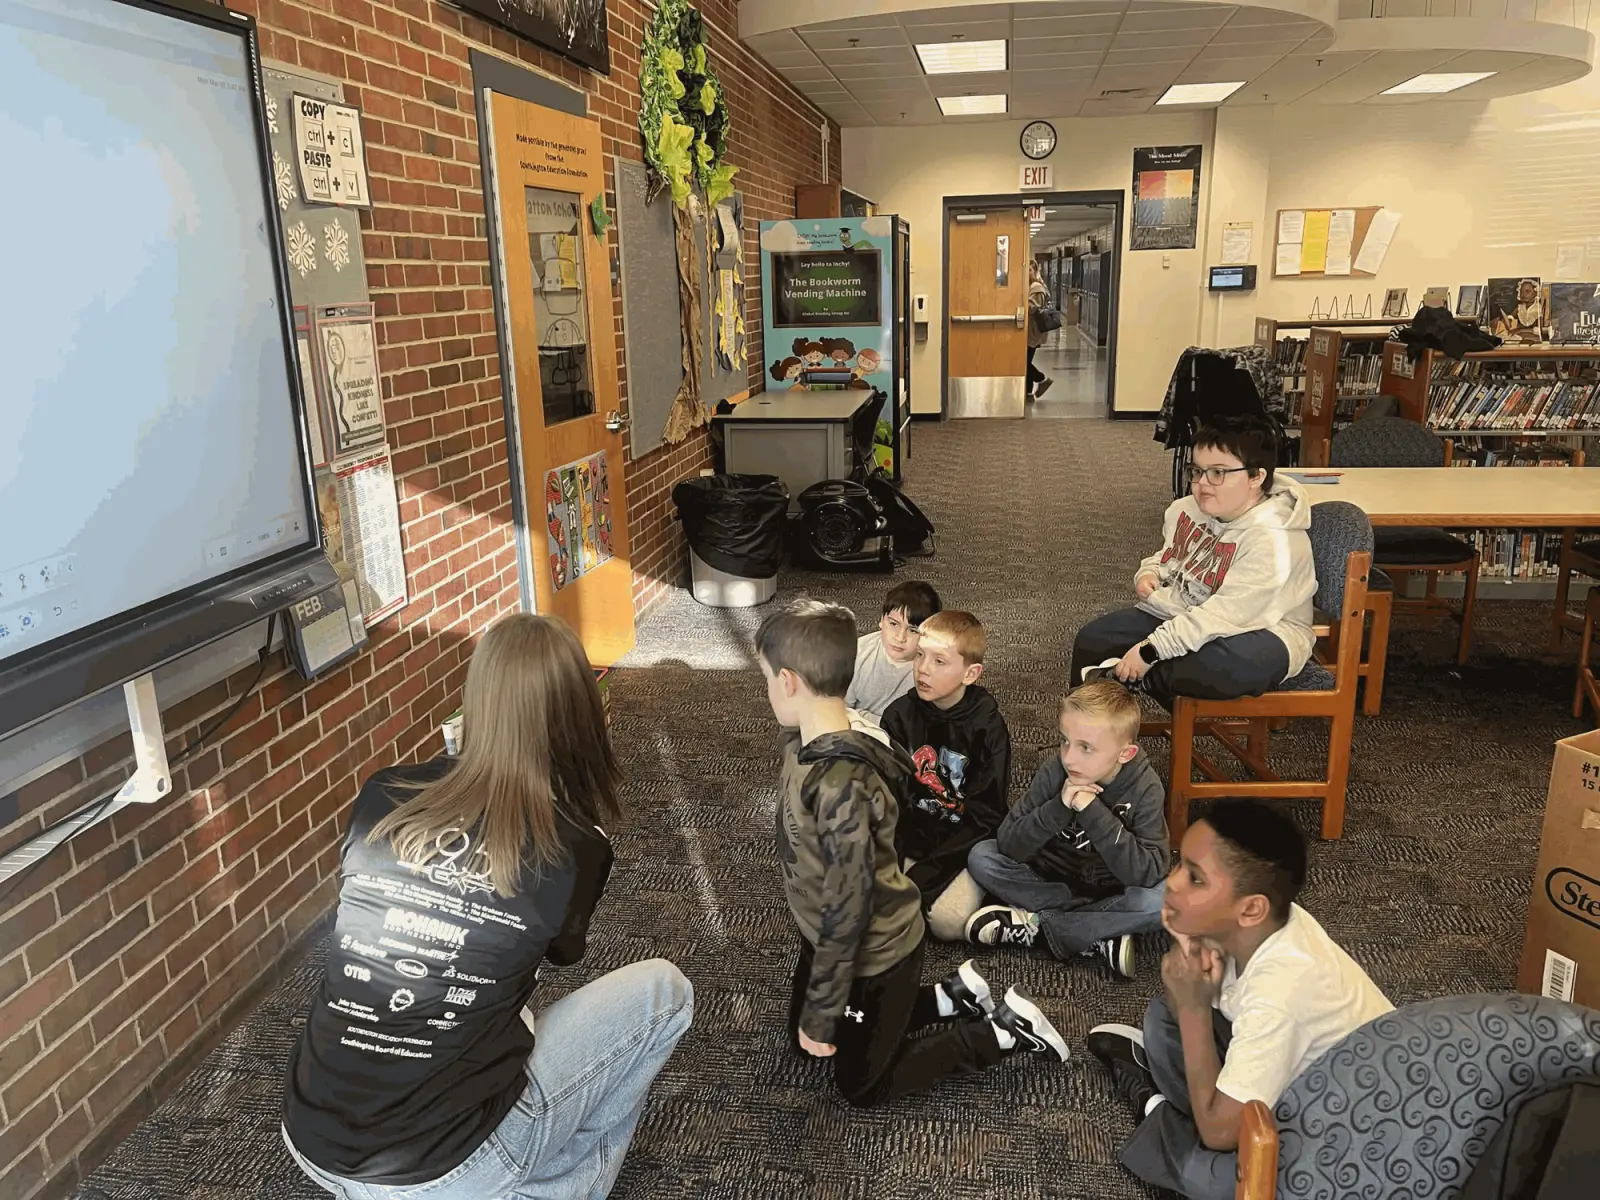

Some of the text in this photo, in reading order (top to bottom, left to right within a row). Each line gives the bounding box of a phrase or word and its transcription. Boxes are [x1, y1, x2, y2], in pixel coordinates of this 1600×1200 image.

[301, 100, 325, 120] COPY
[307, 130, 322, 144] ctrl
[313, 177, 327, 190] ctrl
[1024, 166, 1048, 185] EXIT
[528, 200, 553, 216] atton
[789, 277, 861, 287] The Bookworm
[785, 288, 867, 300] Vending Machine
[295, 595, 322, 621] FEB
[1582, 778, 1595, 790] 15
[385, 907, 470, 946] MOHAWK
[343, 963, 371, 982] OTIS
[340, 1036, 432, 1059] Southington Board of Education
